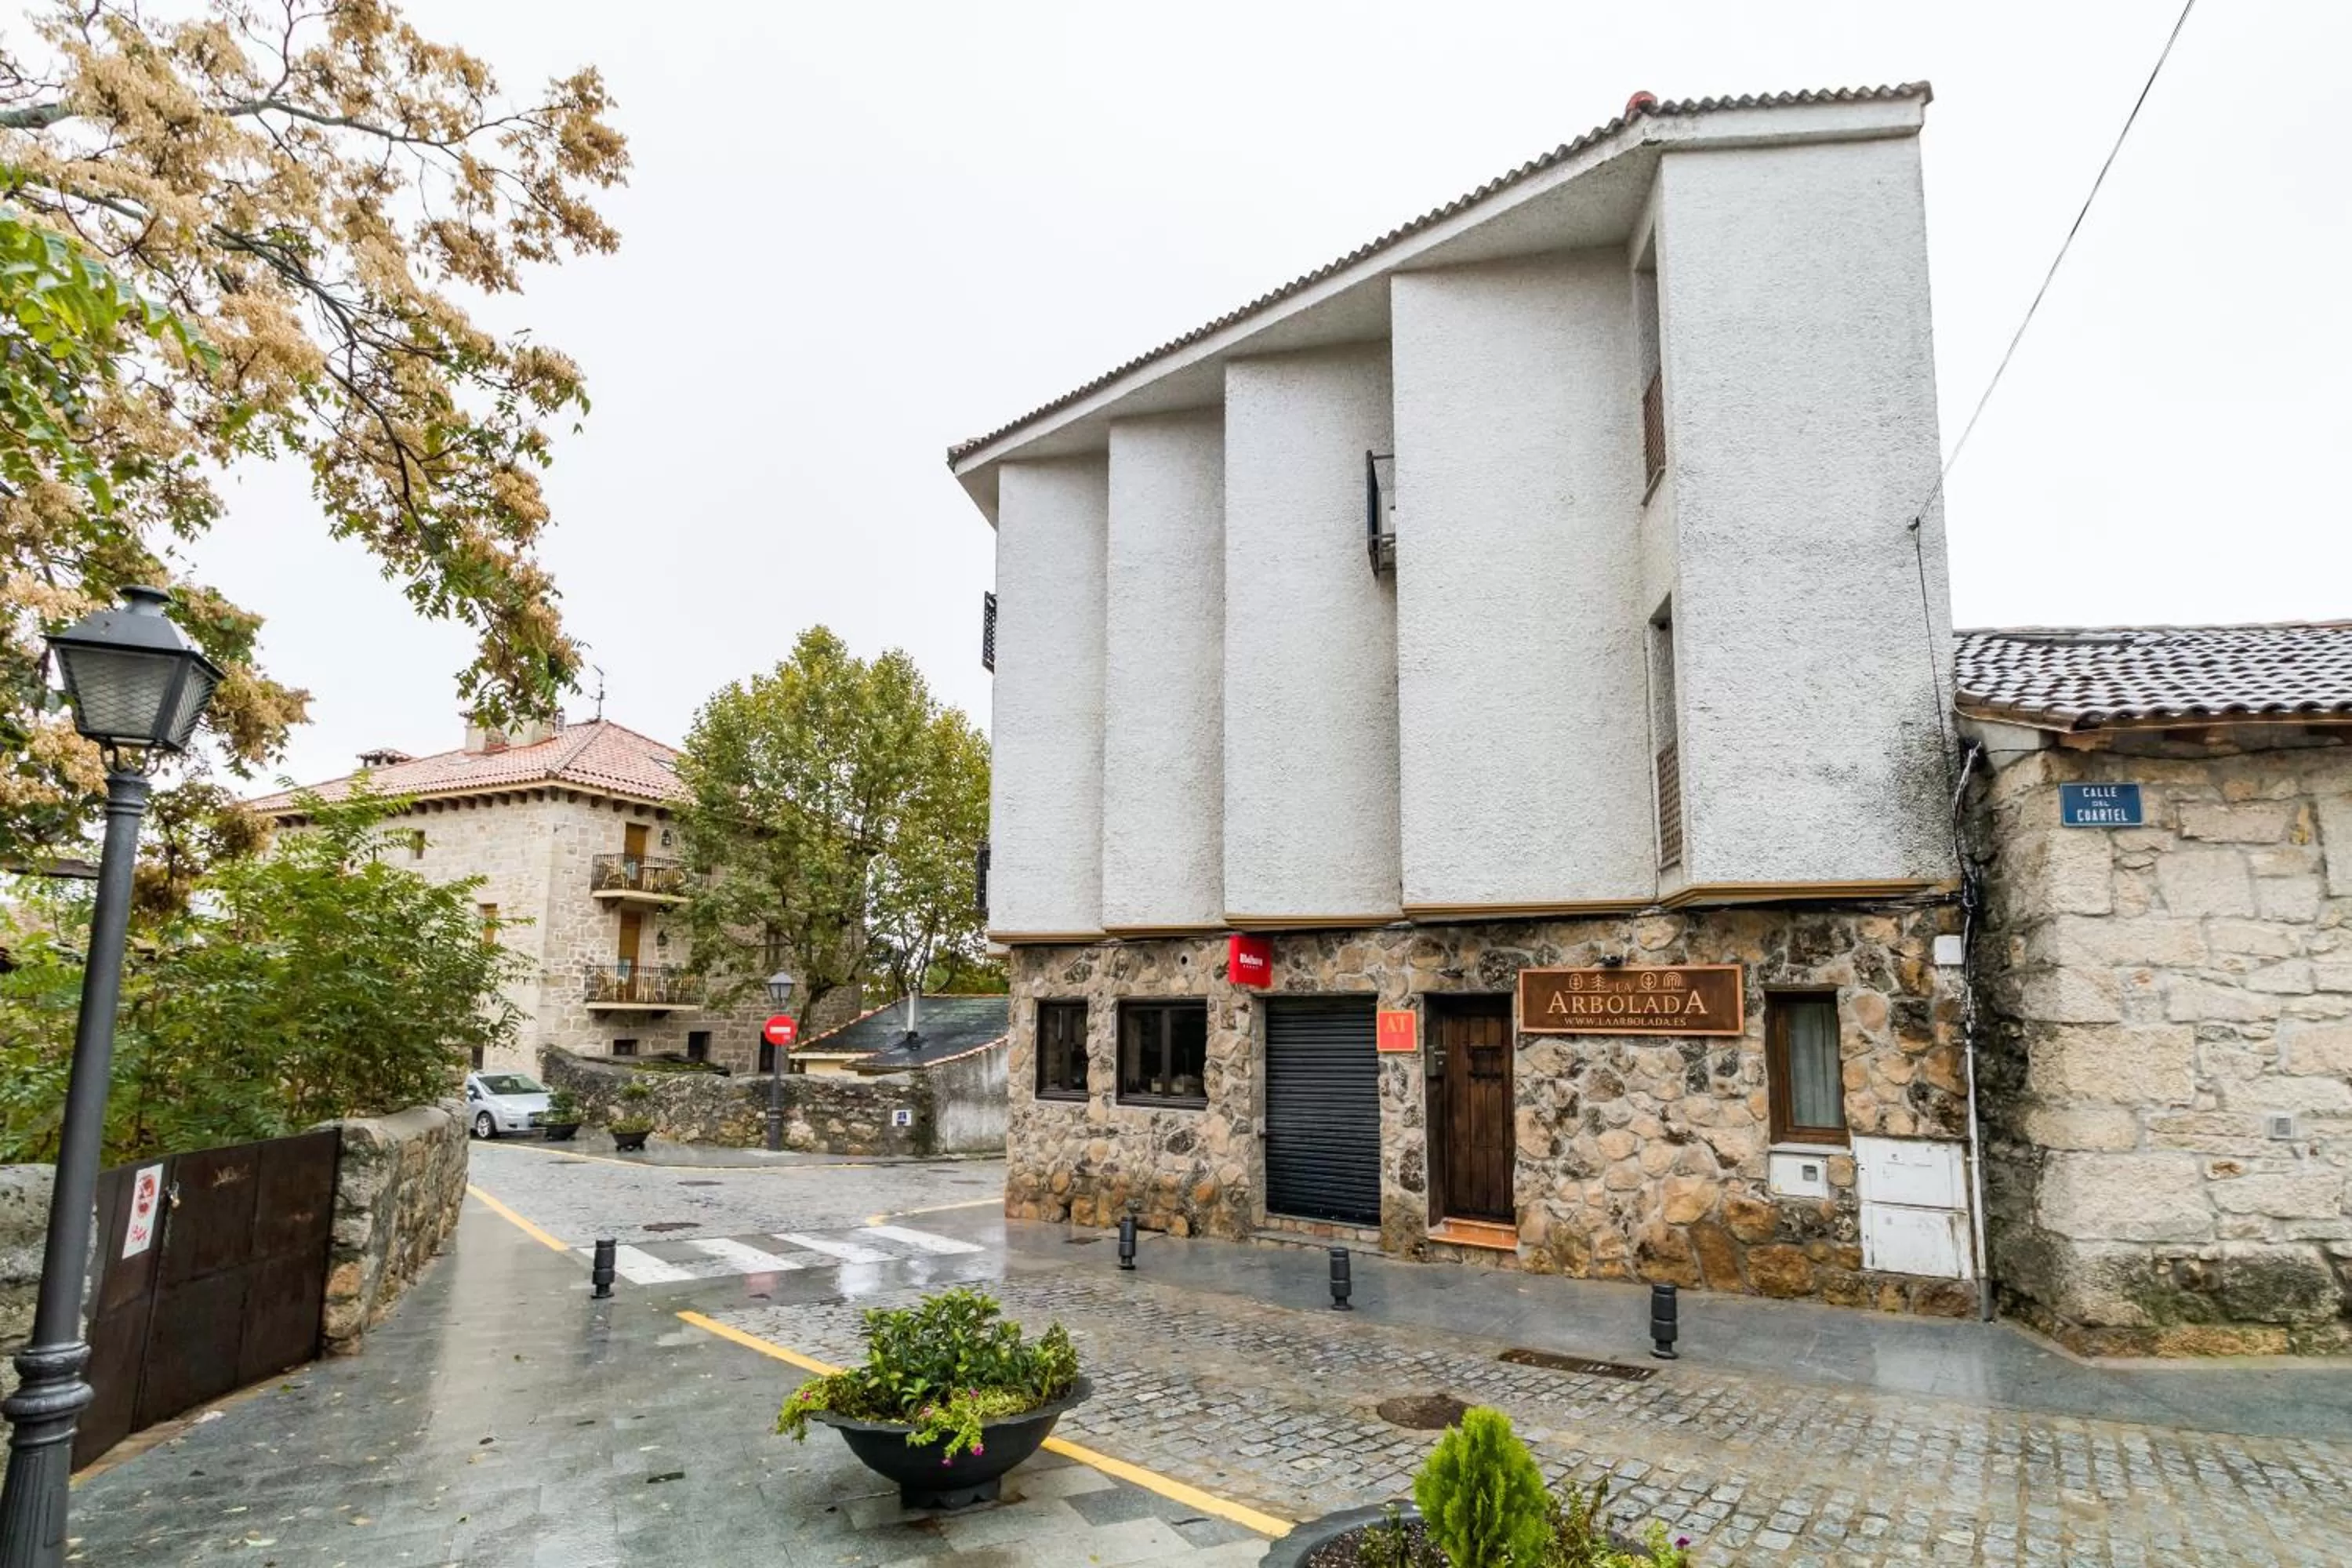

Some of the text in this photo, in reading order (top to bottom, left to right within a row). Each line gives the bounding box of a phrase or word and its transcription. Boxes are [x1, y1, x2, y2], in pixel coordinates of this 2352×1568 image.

[2082, 787, 2118, 797] CALLE
[2077, 809, 2129, 822] CUARTEL
[1615, 982, 1632, 993] LA
[1547, 990, 1708, 1014] ARBOLADA
[1385, 1015, 1408, 1033] AT
